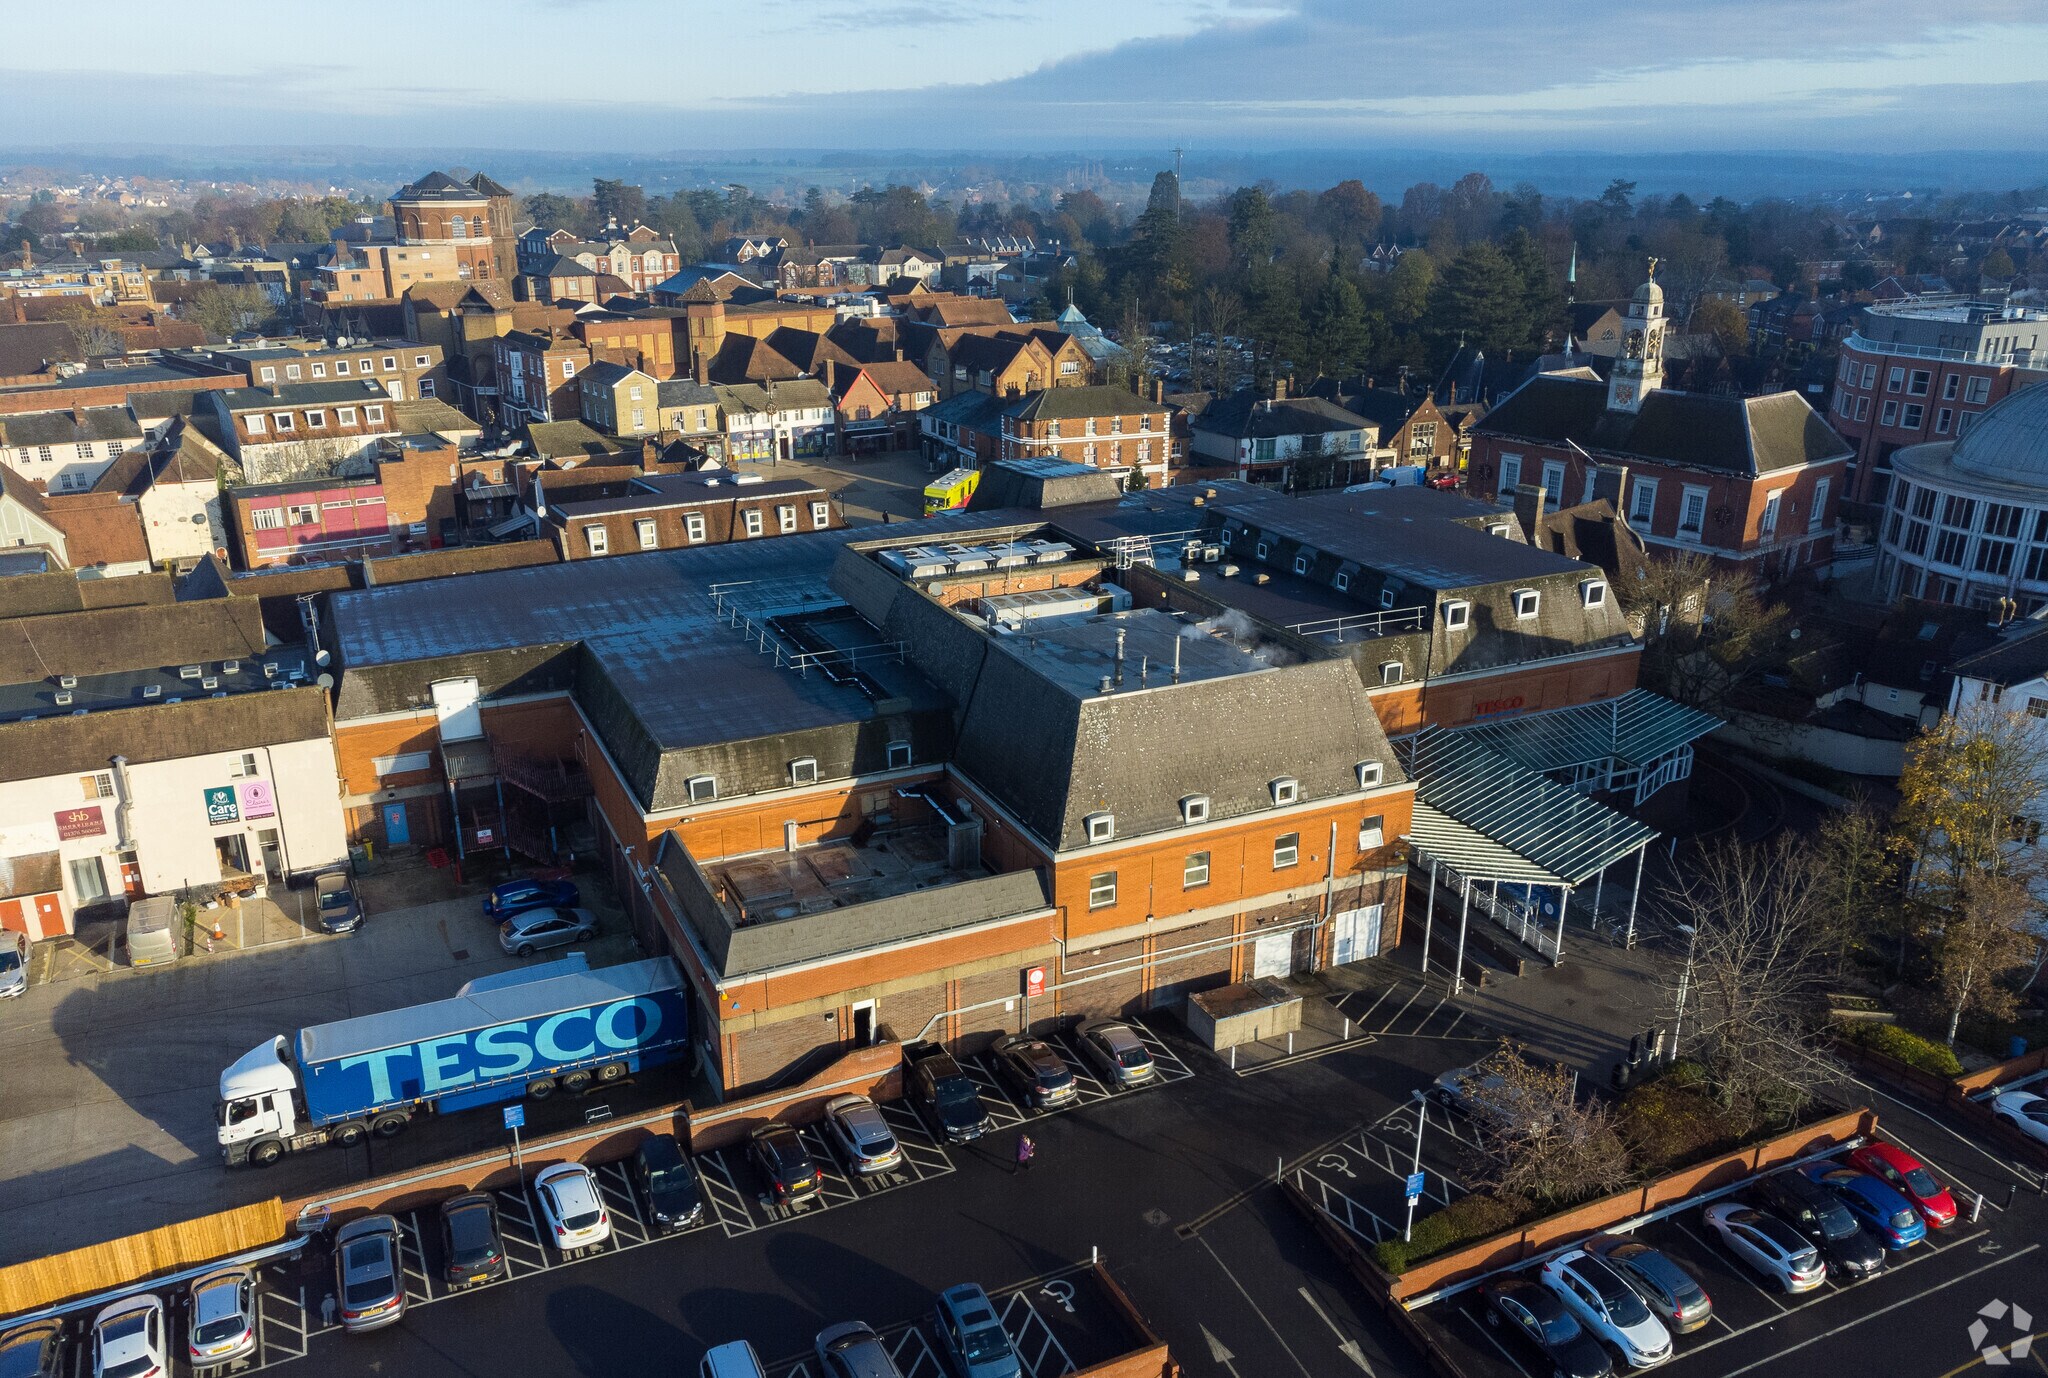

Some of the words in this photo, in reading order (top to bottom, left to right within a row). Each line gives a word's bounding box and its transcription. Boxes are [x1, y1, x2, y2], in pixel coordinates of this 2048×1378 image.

[1476, 696, 1523, 714] TESCO
[69, 811, 89, 822] shb
[208, 803, 237, 815] Care
[340, 997, 662, 1104] TESCO
